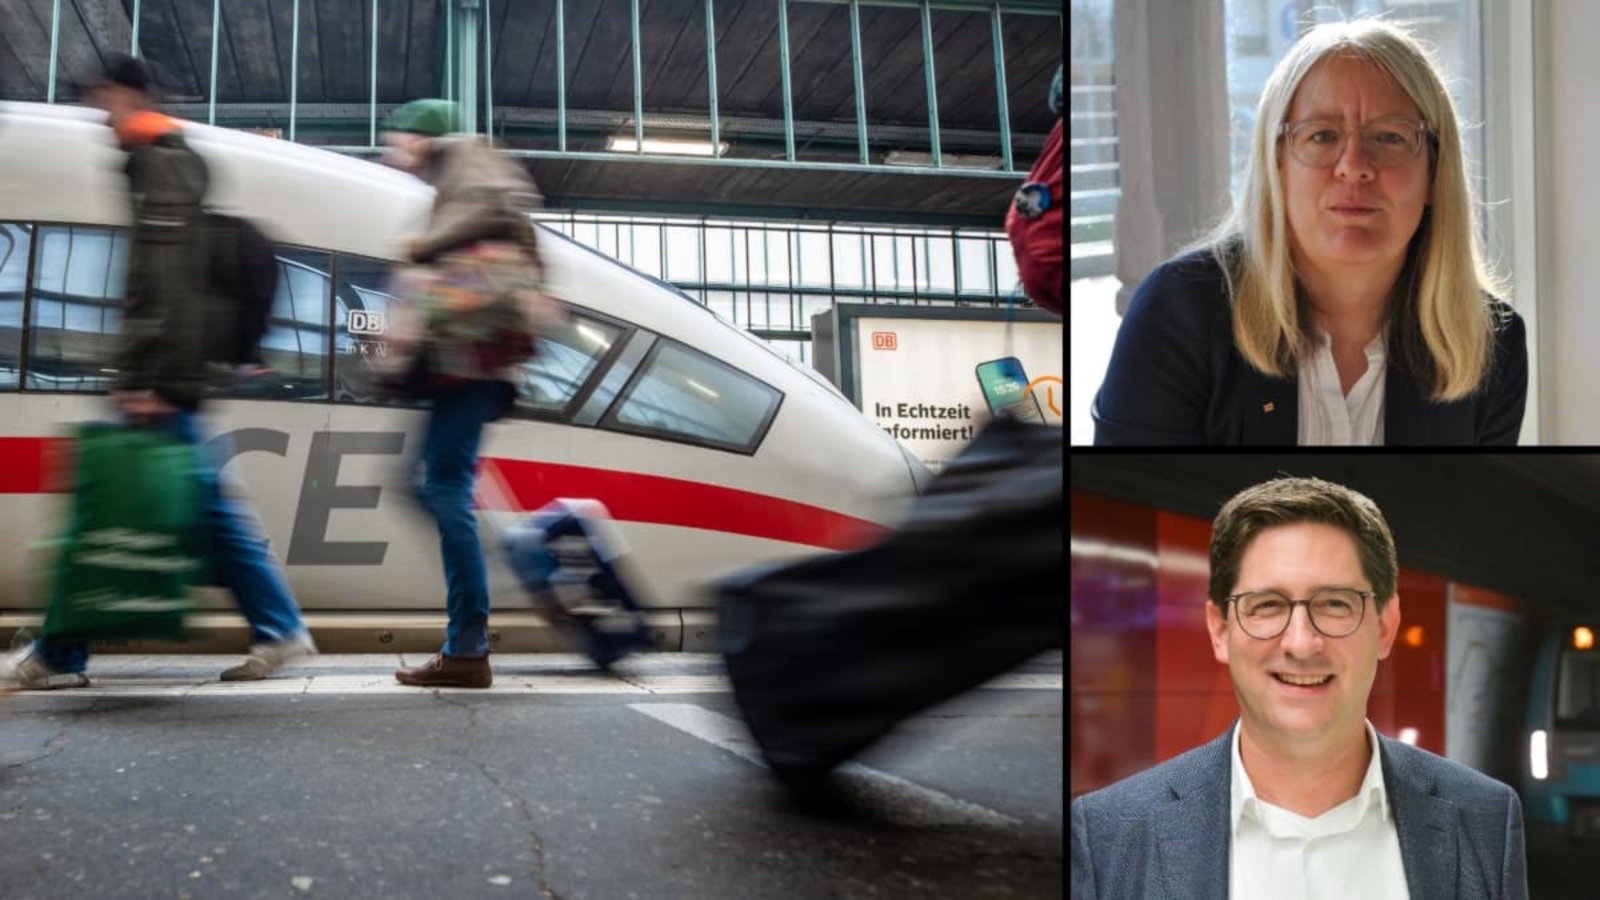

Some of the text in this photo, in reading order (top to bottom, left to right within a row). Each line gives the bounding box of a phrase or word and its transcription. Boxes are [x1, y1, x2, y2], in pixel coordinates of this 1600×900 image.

[350, 312, 382, 332] DB
[874, 333, 895, 348] DB
[875, 402, 971, 419] In Echtzeit
[876, 422, 974, 440] formiert!
